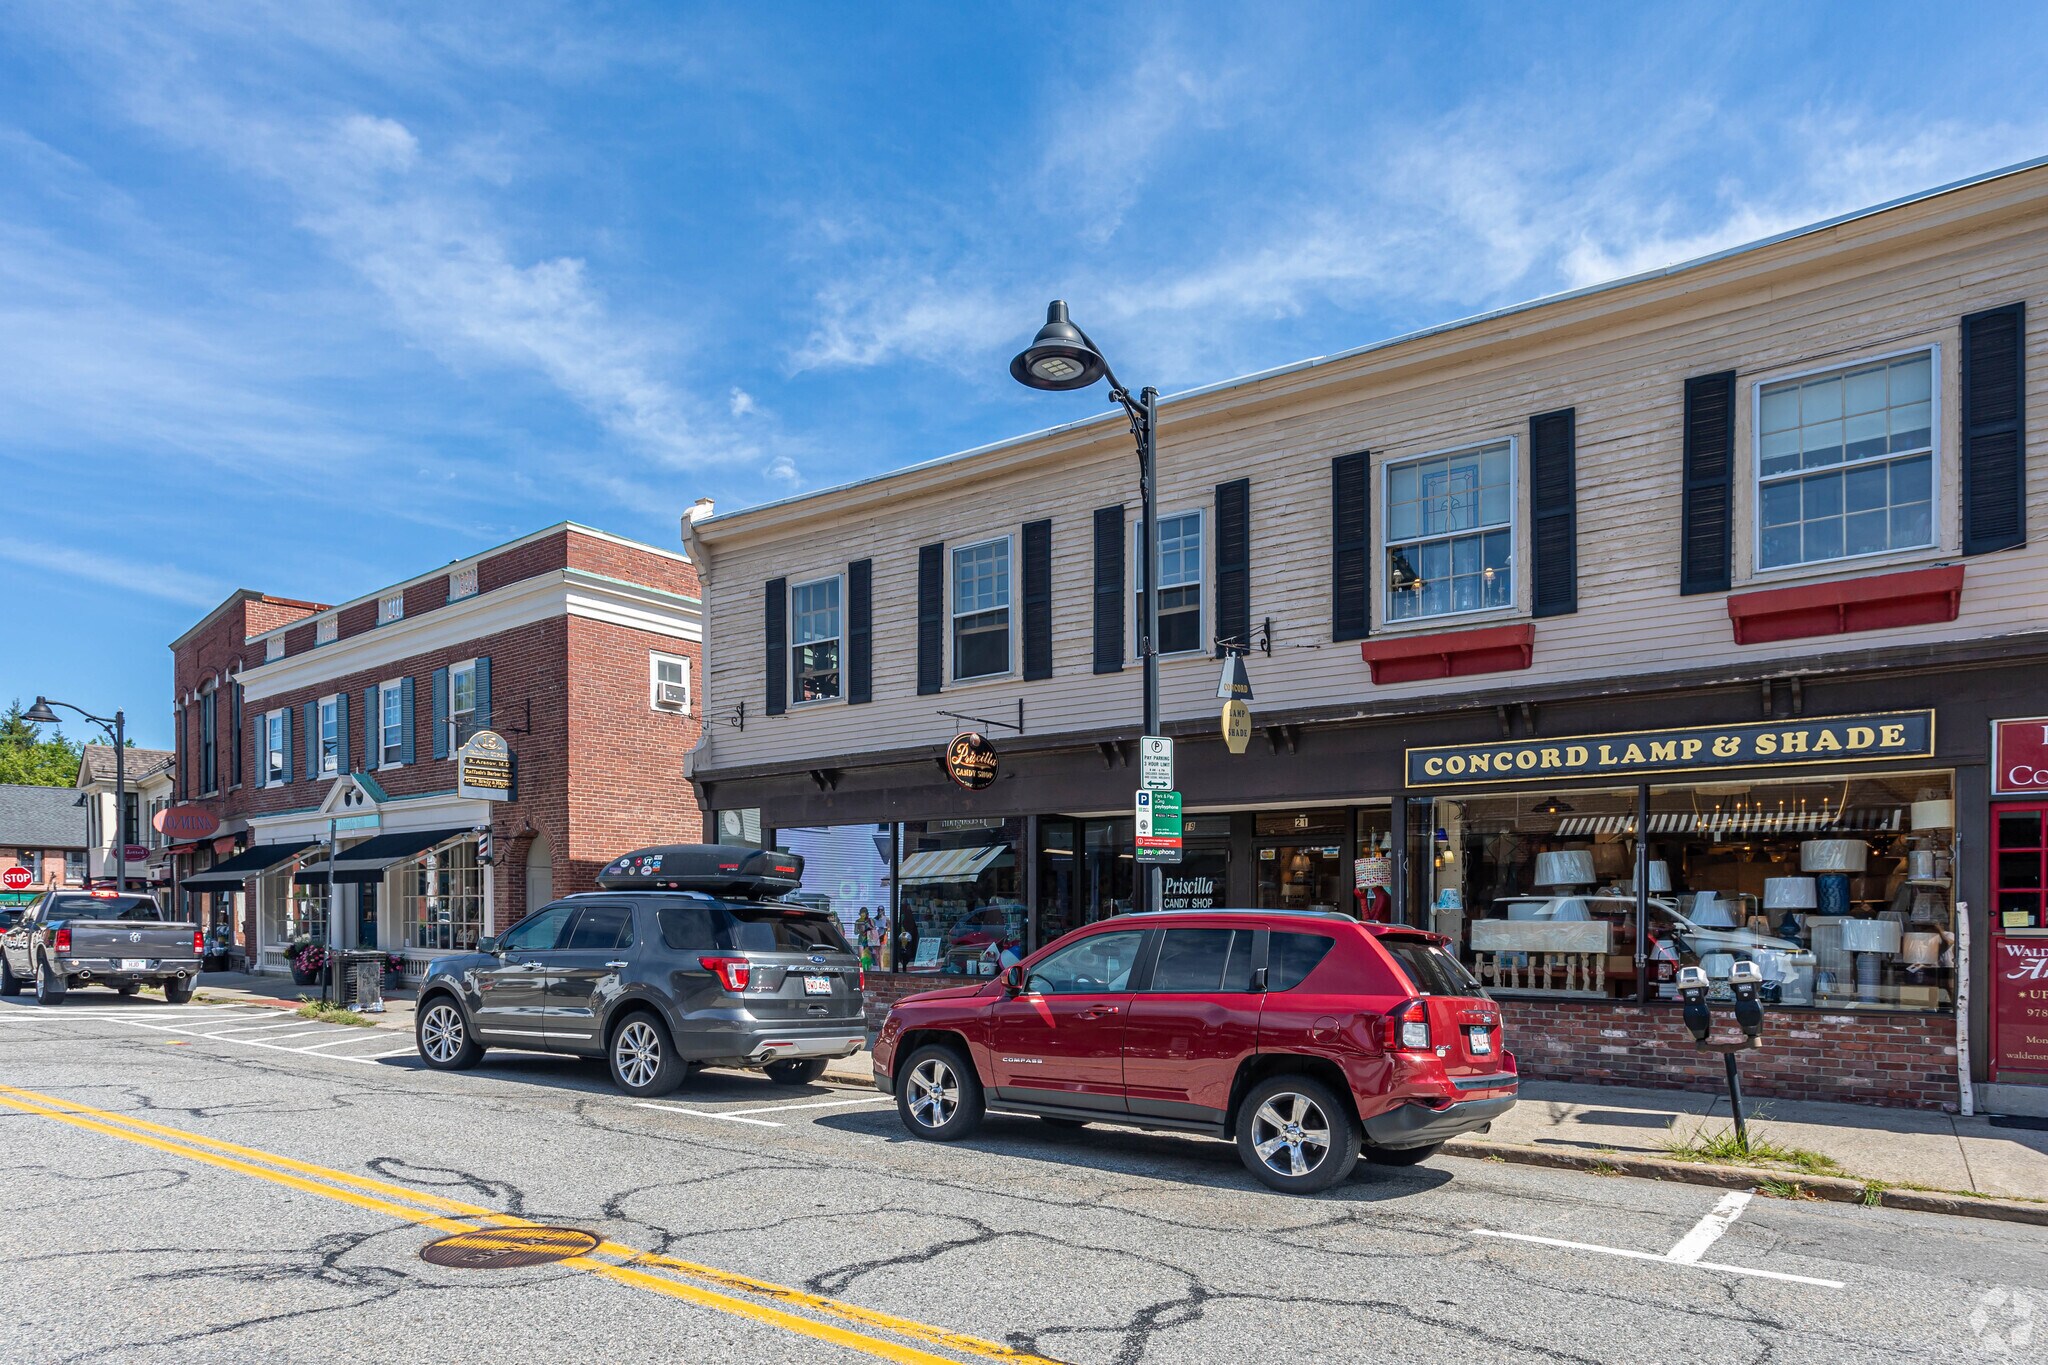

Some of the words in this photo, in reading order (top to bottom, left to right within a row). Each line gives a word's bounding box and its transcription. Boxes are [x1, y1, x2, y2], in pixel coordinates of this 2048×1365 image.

[1224, 683, 1248, 693] CONCORD
[1229, 709, 1246, 718] LAMP
[1228, 728, 1248, 738] SHADE
[482, 735, 496, 747] 15
[951, 742, 997, 767] Priscilla
[1424, 745, 1589, 776] CONCORD
[1598, 738, 1703, 765] LAMP
[1711, 735, 1742, 757] &
[1755, 724, 1907, 756] SHADE
[956, 768, 976, 778] CANDY
[1186, 822, 1196, 831] 19
[1296, 818, 1306, 827] 21
[1143, 848, 1176, 856] paybyphone
[4, 873, 31, 883] STOP
[1164, 876, 1214, 895] Priscilla
[1164, 898, 1189, 909] CANDY
[1191, 898, 1213, 909] SHOP
